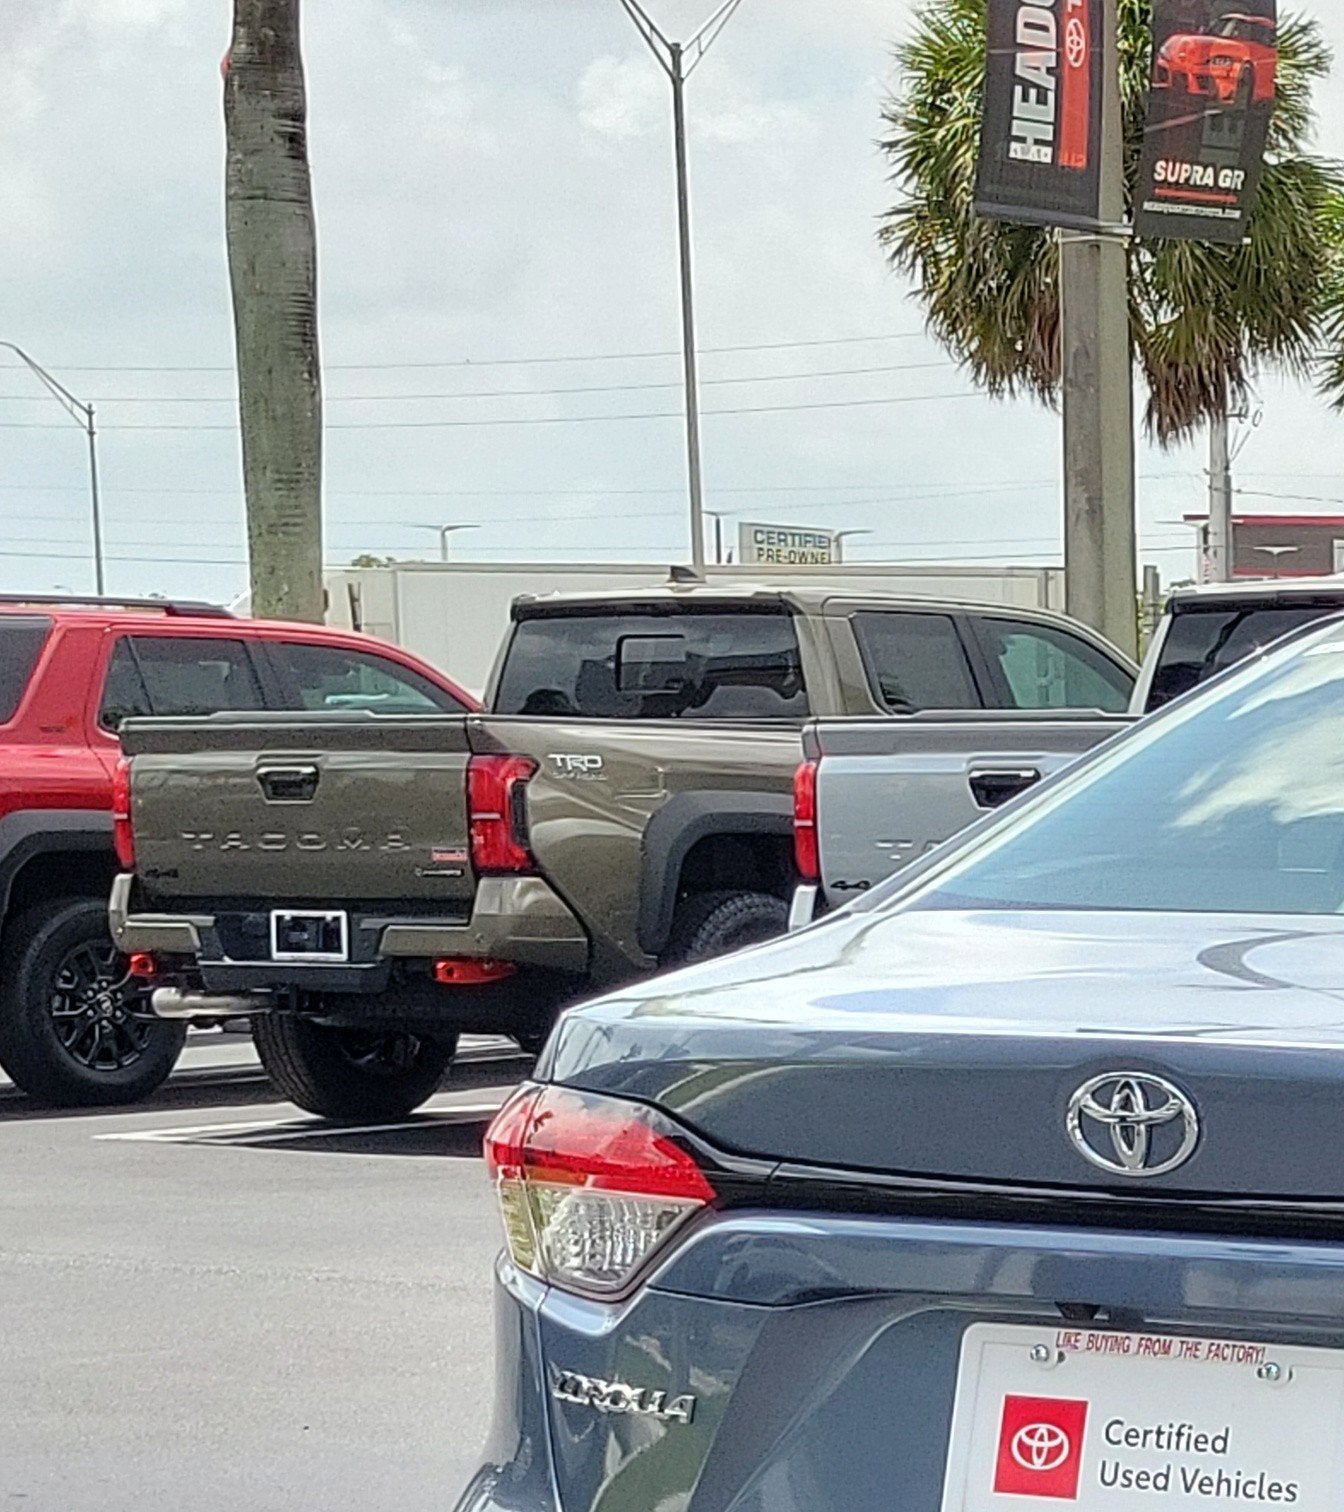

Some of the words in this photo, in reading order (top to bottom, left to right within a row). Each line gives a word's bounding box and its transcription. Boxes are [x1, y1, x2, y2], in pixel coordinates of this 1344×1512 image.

[1009, 0, 1057, 163] HEAD
[1154, 160, 1215, 187] SUPRA
[1218, 168, 1245, 190] GR
[754, 529, 831, 549] CERTIFIE
[756, 547, 831, 564] PRE-OWNE
[547, 754, 602, 771] TRD
[181, 829, 412, 850] TACOMA
[1056, 1331, 1082, 1349] LIKE
[1086, 1334, 1132, 1353] BUYING
[1136, 1337, 1173, 1356] FROM
[1178, 1340, 1202, 1358] THE
[1206, 1343, 1266, 1364] FACTORY!
[1104, 1419, 1230, 1455] Certified
[1099, 1460, 1170, 1493] Used
[1180, 1467, 1299, 1503] Vehicles
